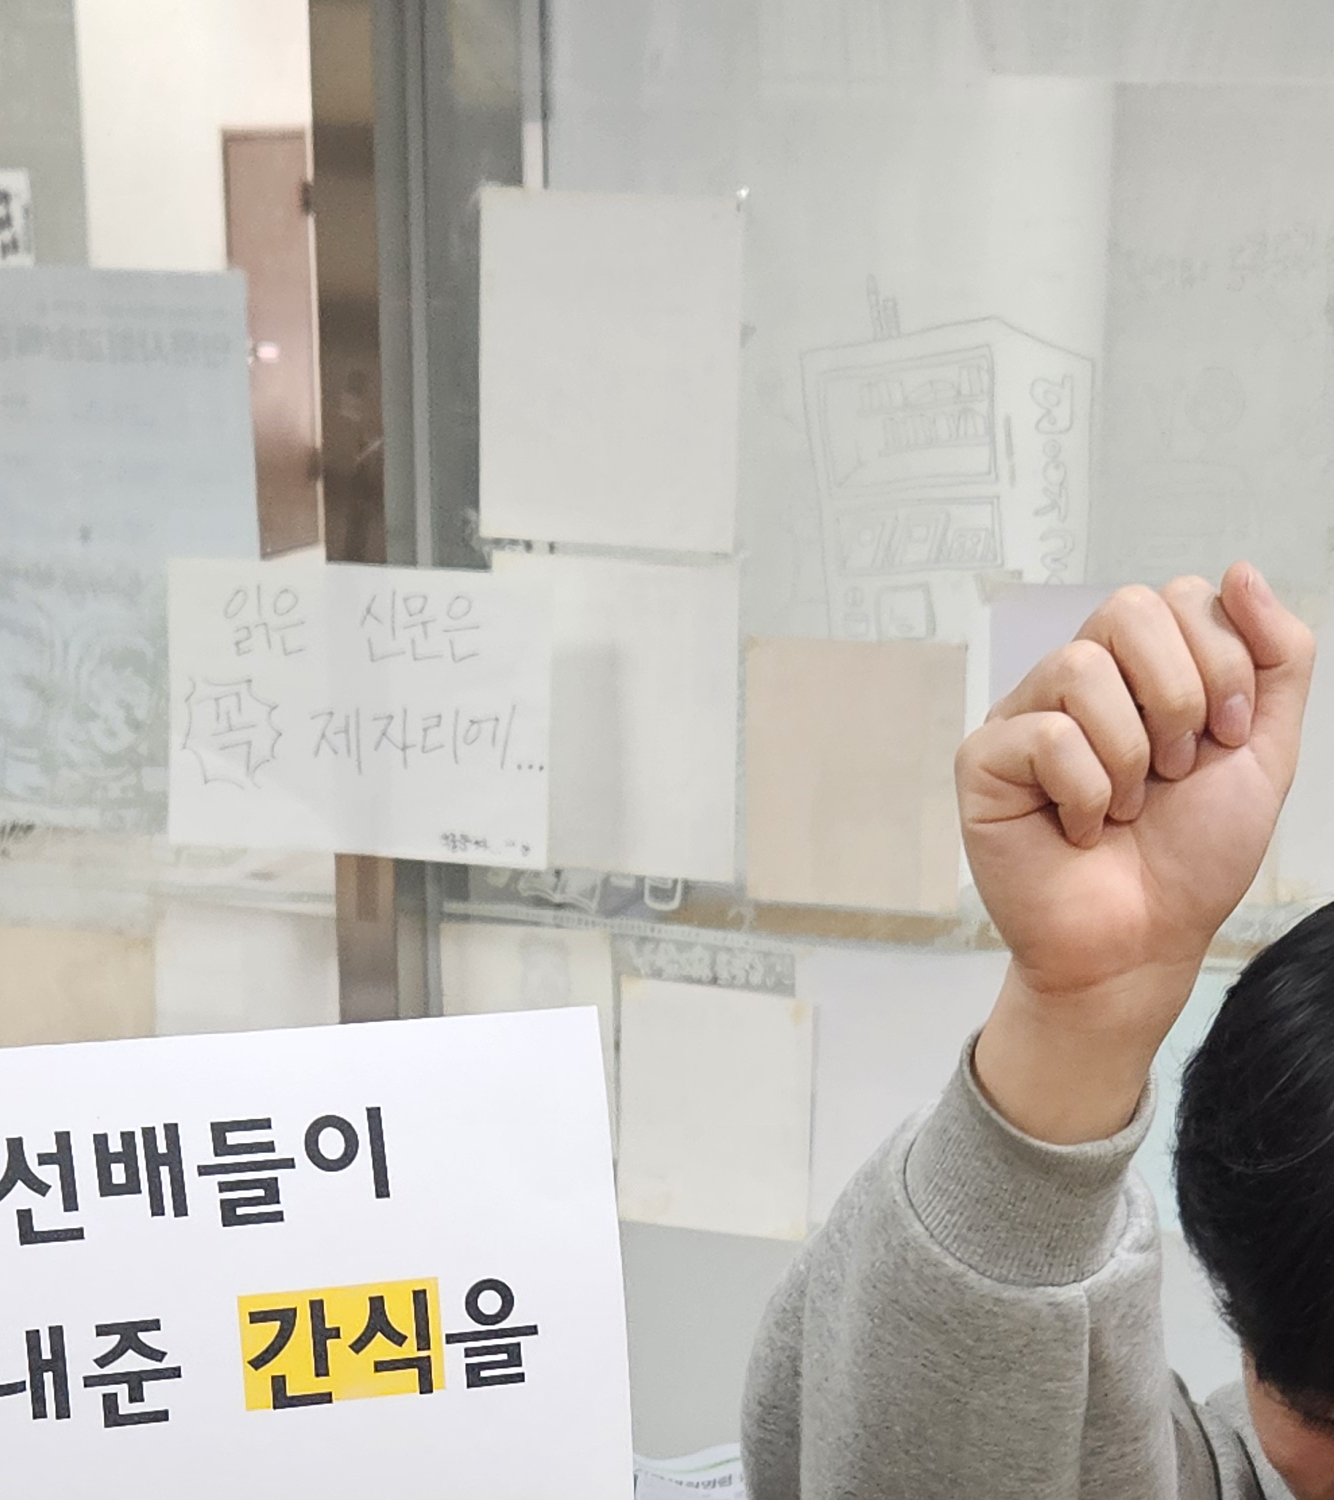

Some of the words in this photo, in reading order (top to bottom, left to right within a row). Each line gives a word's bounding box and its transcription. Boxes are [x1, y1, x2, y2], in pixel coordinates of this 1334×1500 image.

[223, 584, 305, 656] 읽은
[361, 588, 479, 663] 신문은
[211, 690, 257, 777] 꼭
[311, 703, 545, 776] 제자리에...
[247, 1279, 538, 1410] 간식을
